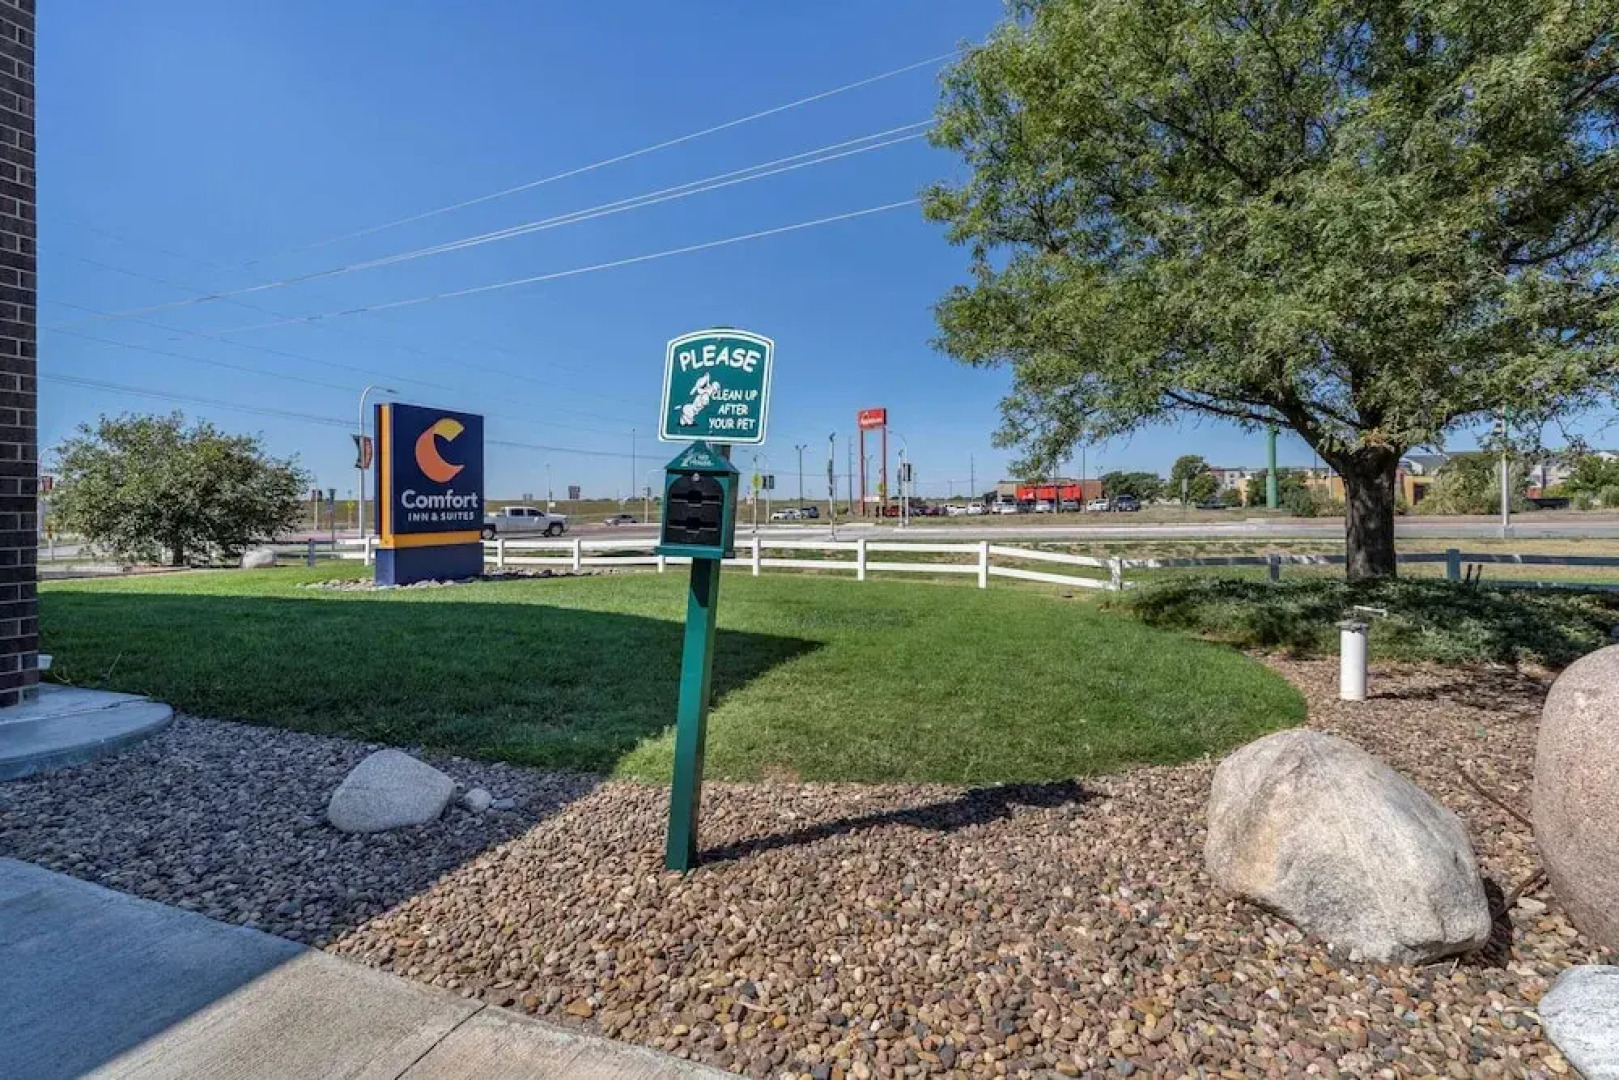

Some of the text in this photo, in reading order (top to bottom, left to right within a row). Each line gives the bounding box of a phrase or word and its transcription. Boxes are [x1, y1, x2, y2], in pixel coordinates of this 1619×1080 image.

[679, 344, 762, 373] PLEASE
[712, 389, 759, 401] CLEAN UP
[718, 404, 749, 415] AFTER
[708, 417, 757, 430] YOUR PET
[401, 488, 479, 509] Comfort
[407, 511, 475, 522] INN & SUITES
